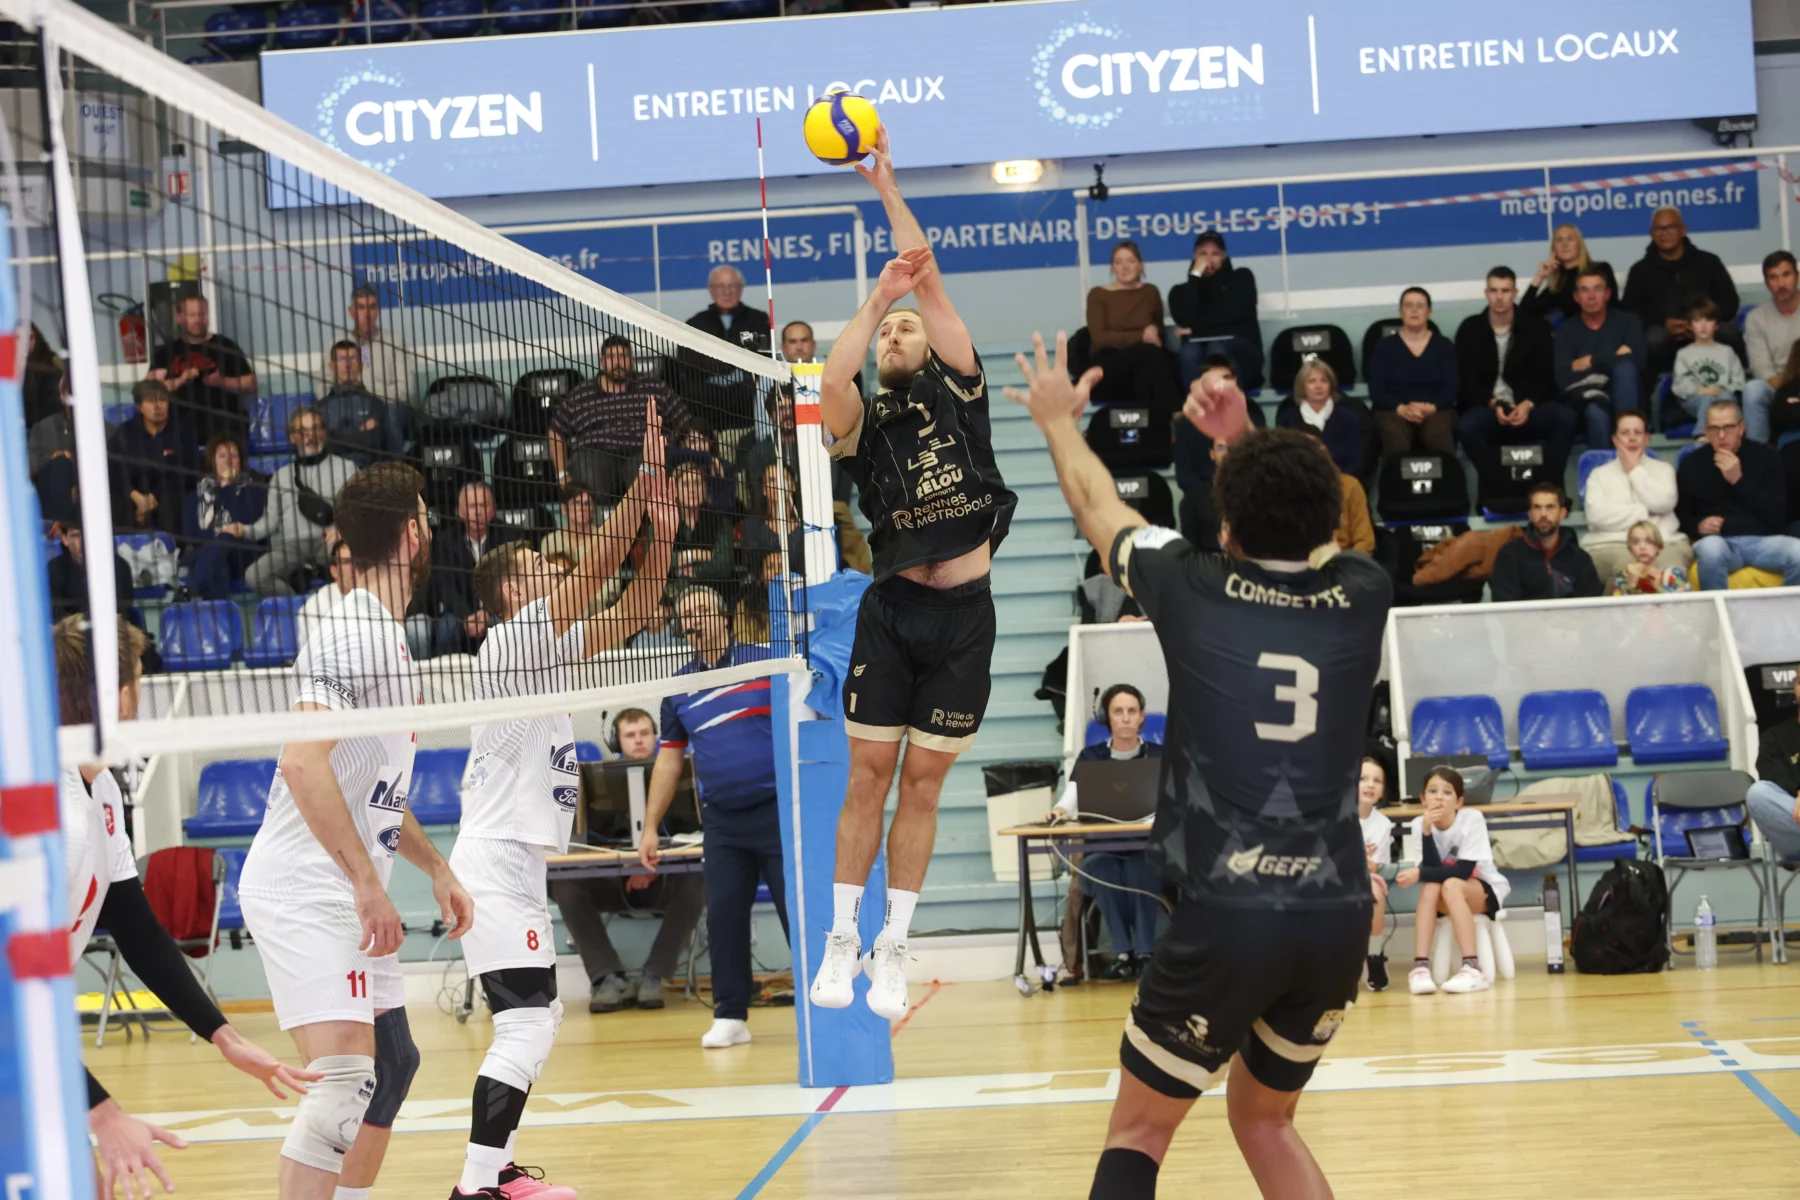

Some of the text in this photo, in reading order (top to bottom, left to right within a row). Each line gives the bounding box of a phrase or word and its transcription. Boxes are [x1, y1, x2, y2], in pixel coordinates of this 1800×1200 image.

[1359, 28, 1679, 74] ENTRETIEN LOCAUX
[1061, 43, 1265, 99] CITYZEN
[633, 84, 795, 121] ENTRETIEN
[345, 91, 543, 146] CITYZEN
[1096, 216, 1131, 239] DE
[1136, 211, 1207, 237] TOUS
[1215, 208, 1261, 233] LES
[1118, 413, 1140, 423] VIP
[1510, 450, 1533, 461] VIP
[1410, 461, 1433, 473] VIP
[1117, 481, 1139, 493] VIP
[1422, 525, 1443, 537] VIP
[1225, 572, 1351, 608] COMBETTE
[1772, 670, 1797, 683] VIP
[849, 692, 858, 713] 1
[1254, 652, 1319, 742] 3
[947, 711, 964, 721] Ville
[1257, 855, 1321, 877] GEFF
[526, 929, 539, 951] 8
[347, 970, 367, 998] 11
